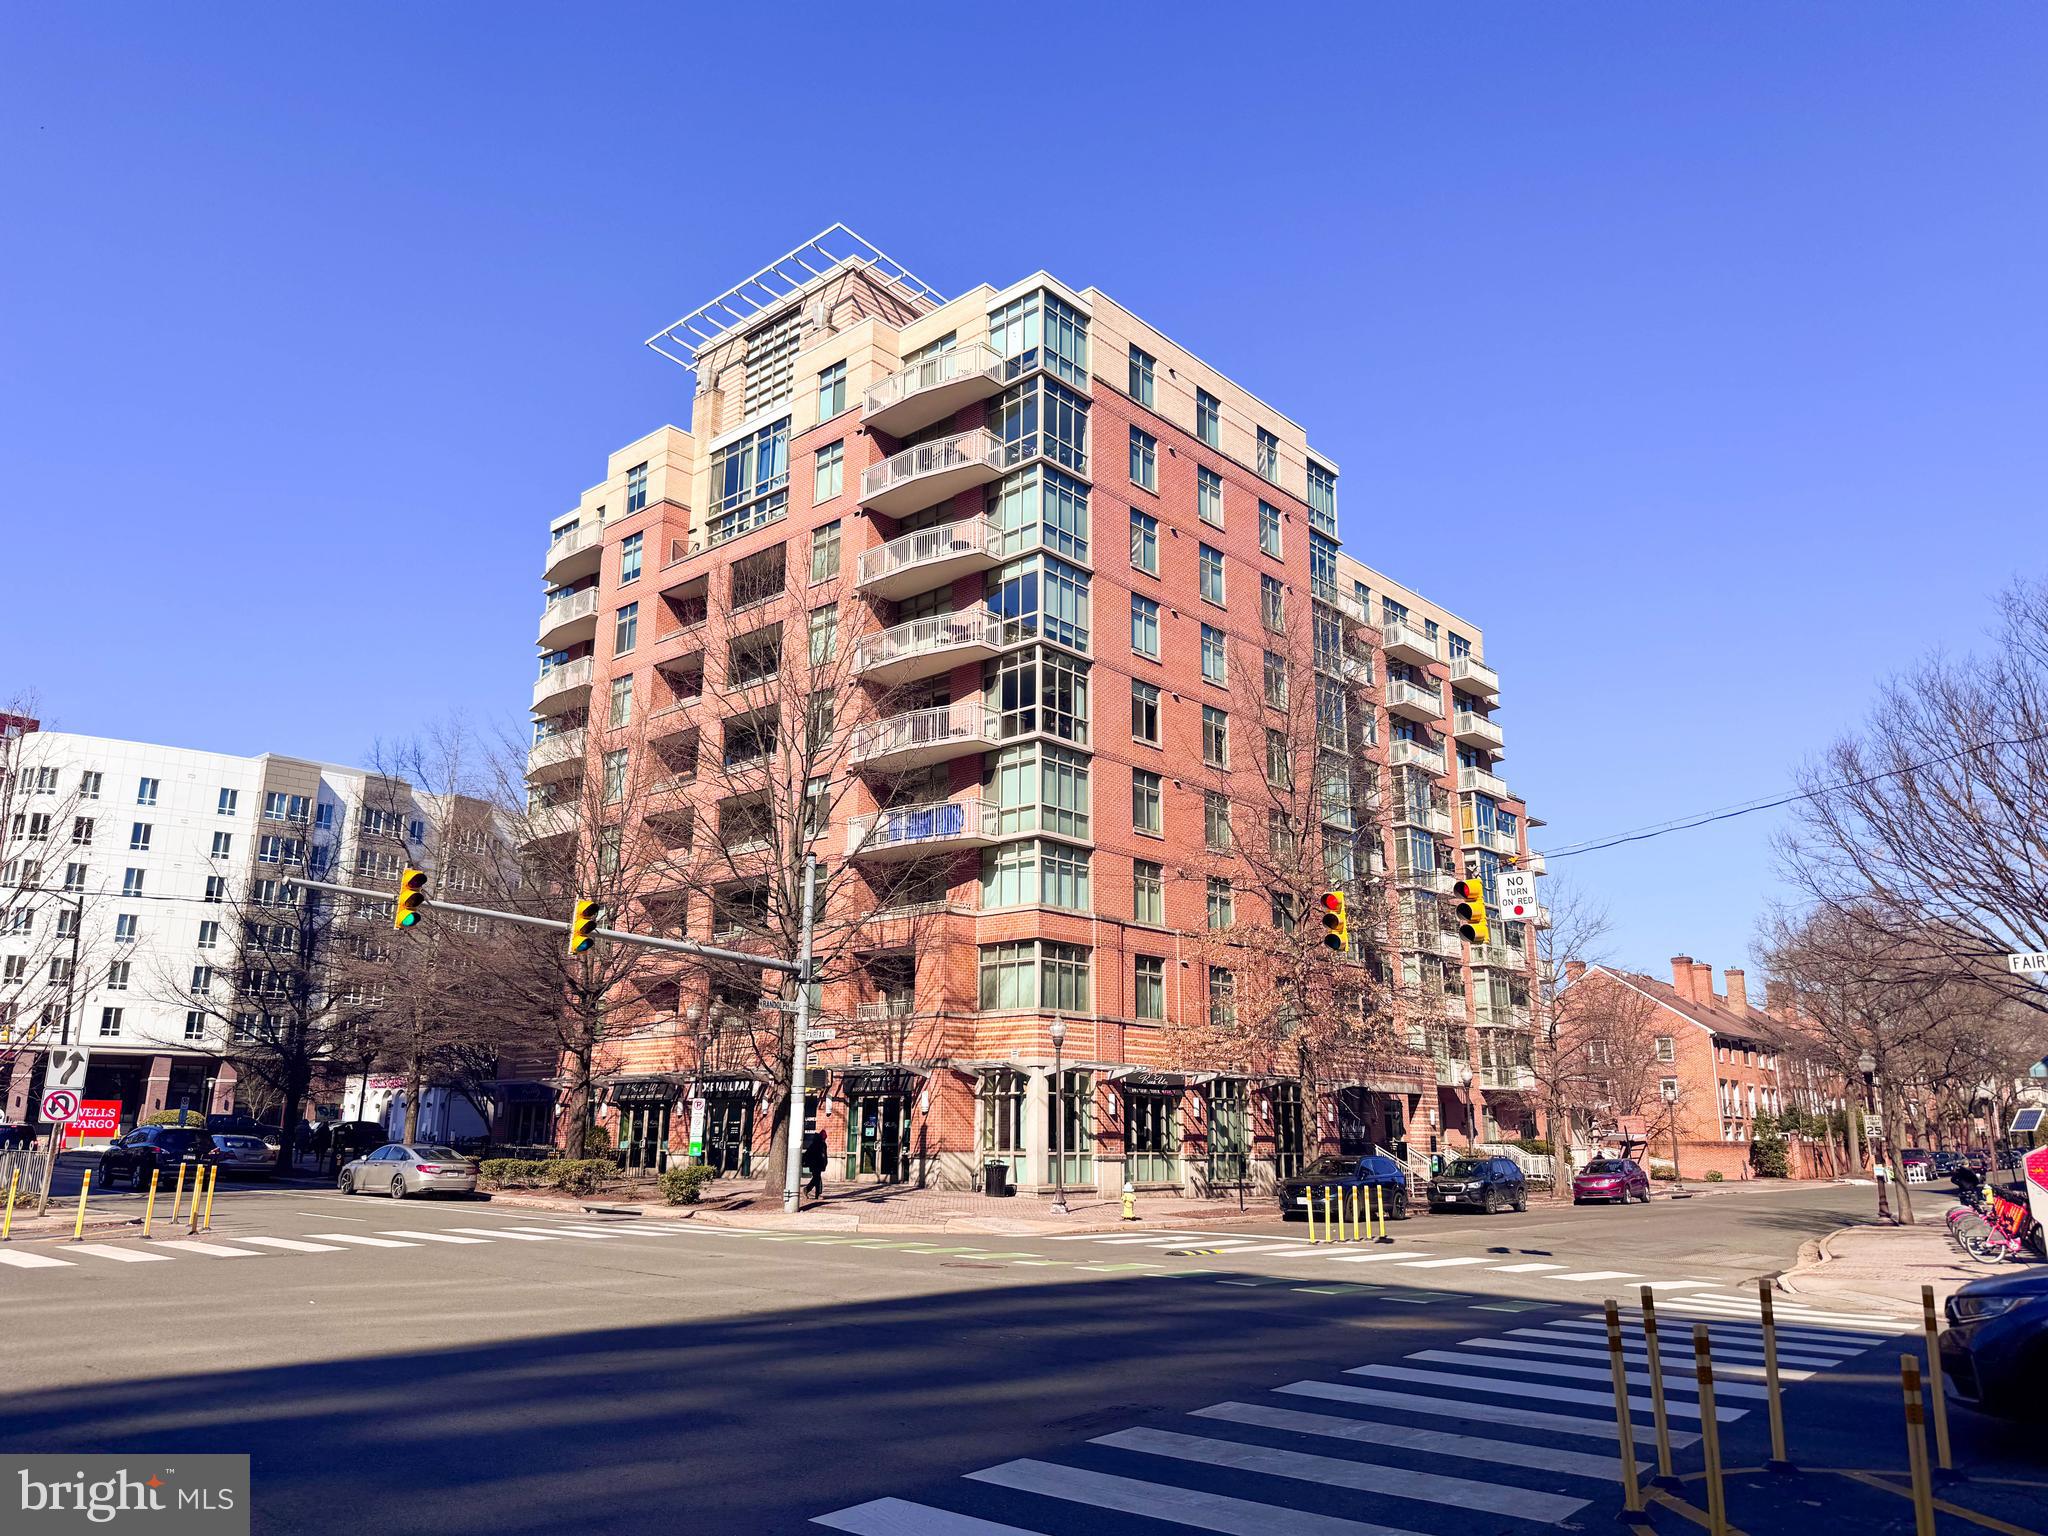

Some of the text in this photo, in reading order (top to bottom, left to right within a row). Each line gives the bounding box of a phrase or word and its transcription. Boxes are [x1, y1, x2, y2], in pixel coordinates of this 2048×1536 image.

[1507, 876, 1524, 887] NO
[1506, 887, 1529, 897] TURN
[1502, 896, 1534, 907] ON RED
[2013, 955, 2048, 970] FAIR
[762, 1000, 790, 1011] RANDOLPH
[806, 1030, 826, 1039] FAIRFAX
[71, 1119, 115, 1129] FARGO
[1866, 1126, 1883, 1136] 25
